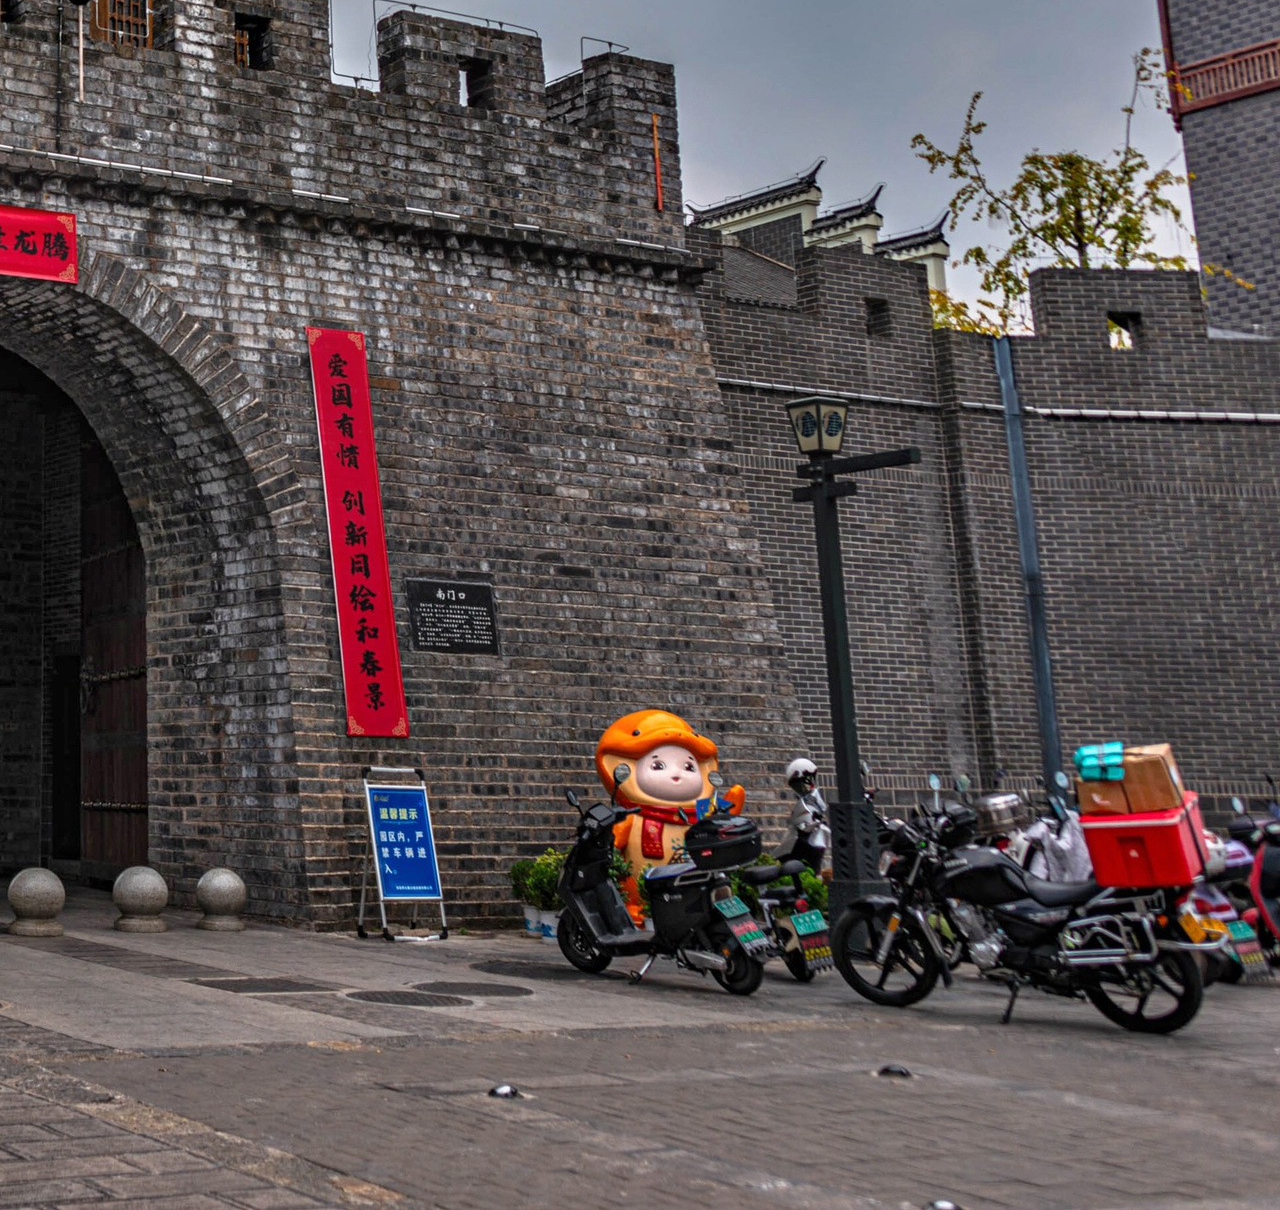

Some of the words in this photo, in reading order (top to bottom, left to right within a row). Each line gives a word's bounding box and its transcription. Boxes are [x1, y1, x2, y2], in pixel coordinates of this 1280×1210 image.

[328, 353, 360, 470] 爱国有情
[436, 588, 466, 601] 南门口
[379, 807, 419, 820] 温馨提示
[381, 847, 427, 859] 禁车辆进
